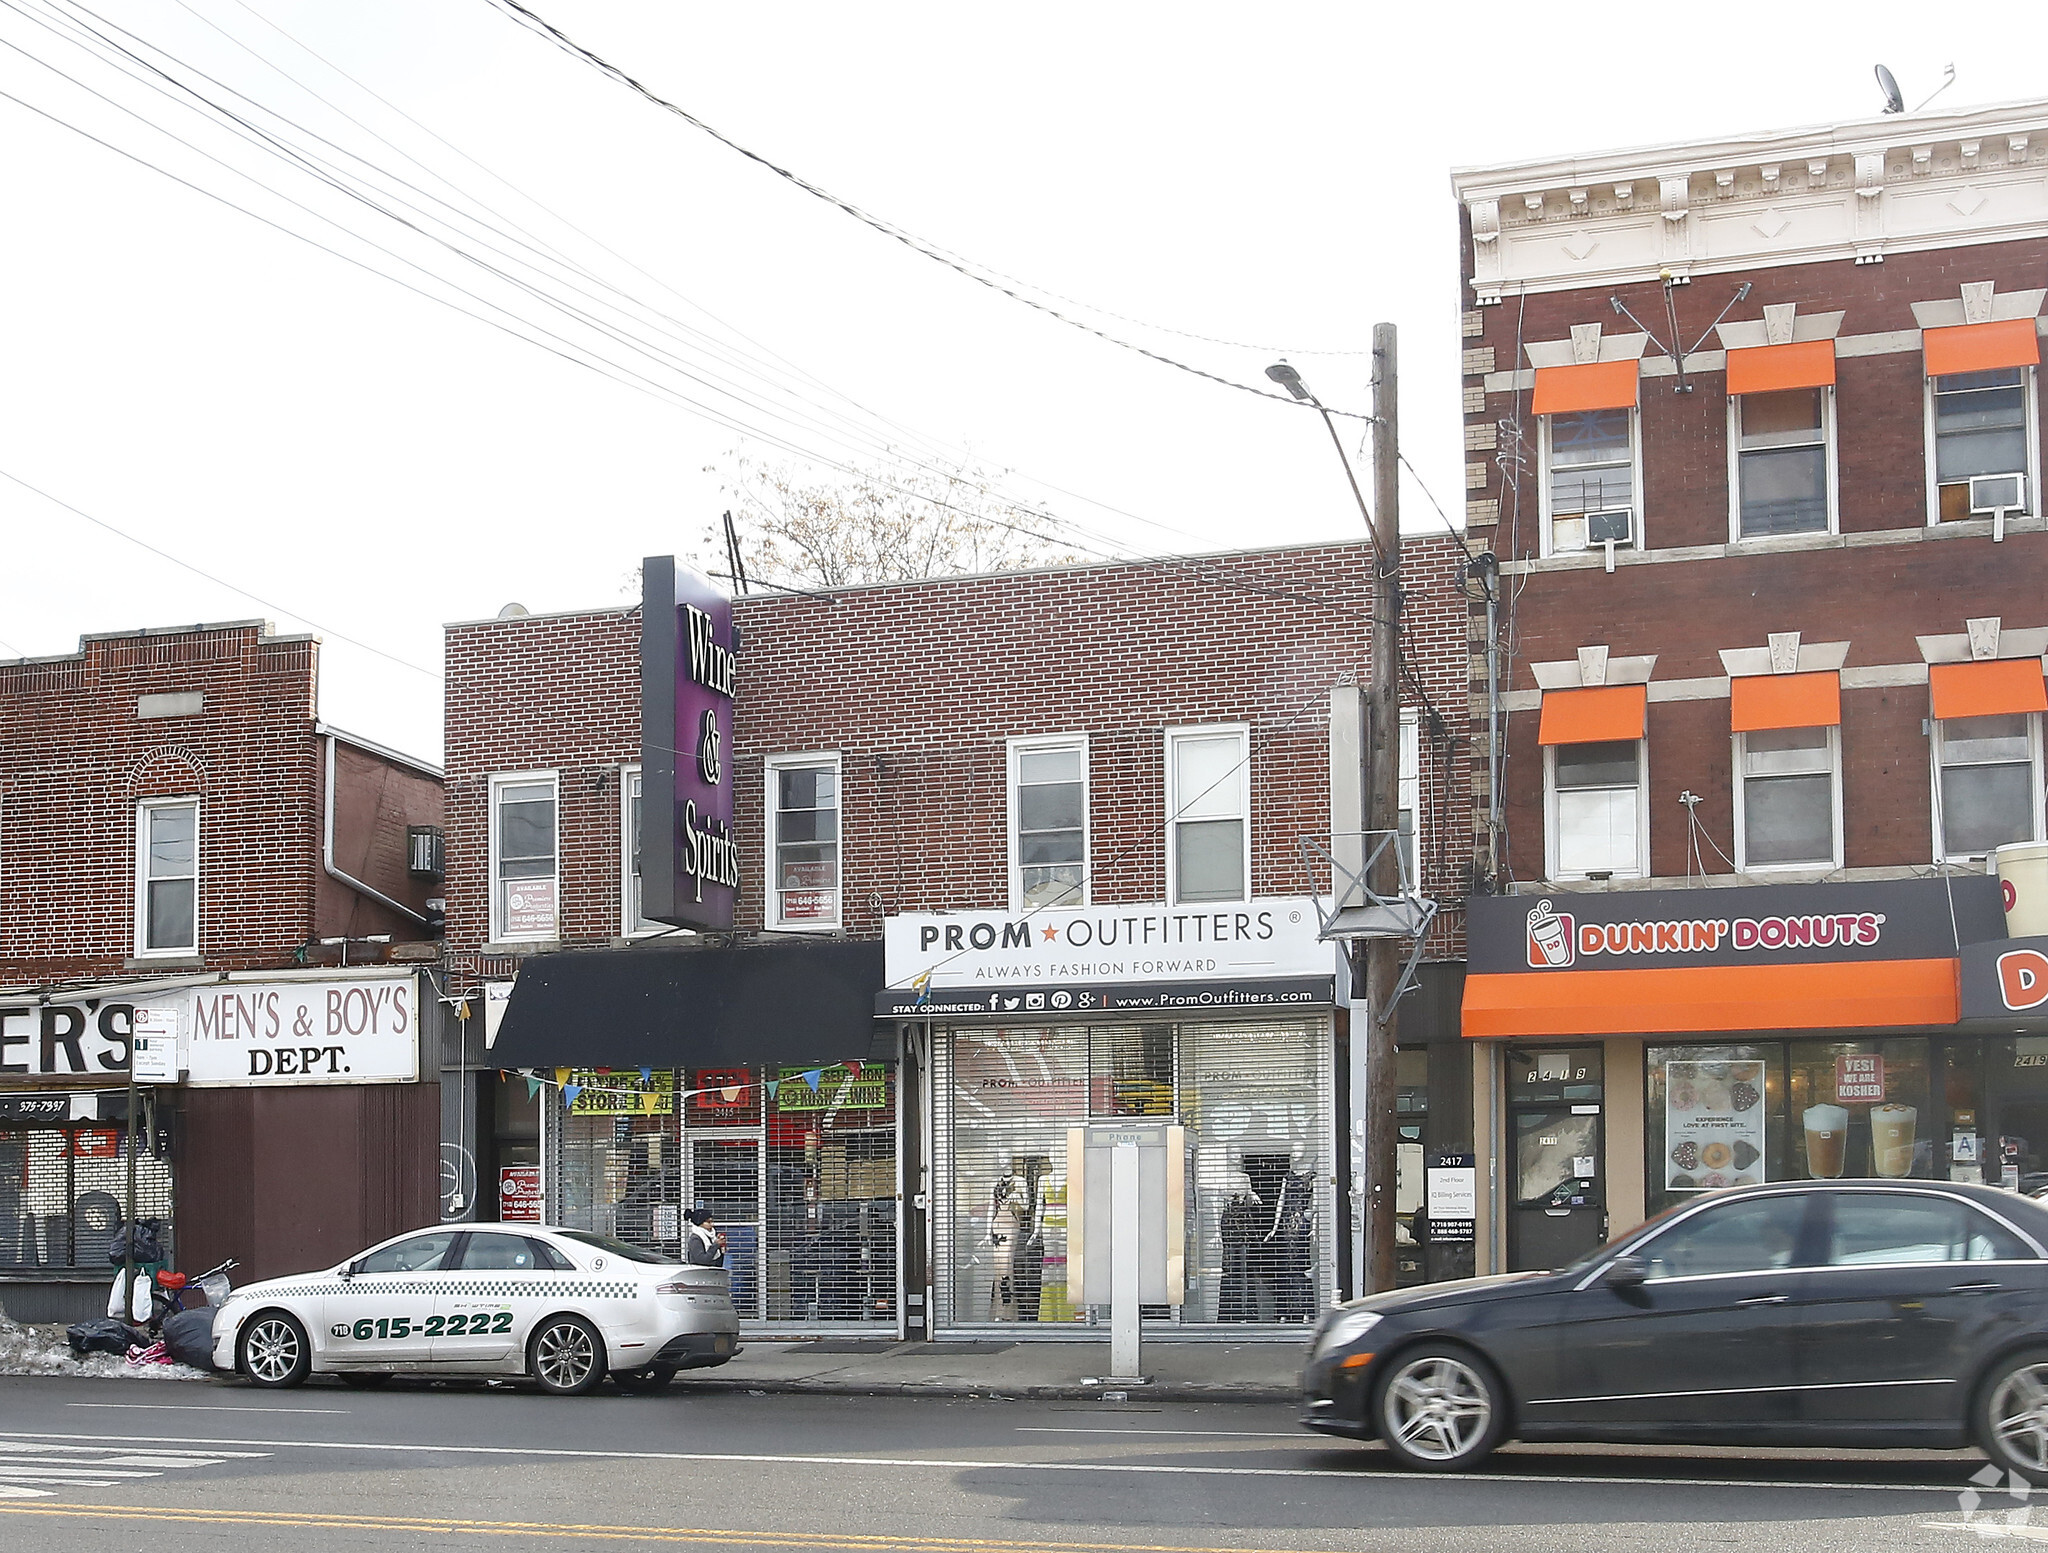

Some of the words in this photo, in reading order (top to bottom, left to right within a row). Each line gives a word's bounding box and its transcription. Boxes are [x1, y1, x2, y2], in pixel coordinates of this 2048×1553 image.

[685, 603, 737, 699] Wine
[702, 709, 721, 786] &
[685, 799, 738, 903] Spirits
[516, 884, 547, 892] AVAILABLE
[920, 921, 1033, 952] PROM
[1066, 911, 1275, 947] OUTFITTERS
[1581, 921, 1727, 953] DUNKIN'
[1734, 914, 1878, 948] DONUTS
[975, 962, 1042, 979] ALWAYS
[1050, 961, 1124, 977] FASHION
[1132, 958, 1217, 974] FORWARD
[892, 1004, 917, 1014] STAY
[919, 1003, 985, 1013] CONNECTED:
[1115, 990, 1313, 1008] www.PromOutfitters.com
[193, 991, 280, 1041] MEN'S
[292, 1004, 314, 1037] &
[326, 985, 409, 1036] BOY'S
[248, 1046, 351, 1076] DEPT.
[1845, 1060, 1875, 1072] YES!
[2015, 1055, 2047, 1066] 2419
[1843, 1073, 1858, 1083] WE
[1858, 1073, 1876, 1083] ARE
[1839, 1085, 1881, 1097] KOSHER
[1108, 1133, 1142, 1141] Phone
[1957, 1136, 1972, 1153] A
[1440, 1156, 1463, 1166] 2417
[1438, 1191, 1452, 1199] Billing
[594, 1258, 603, 1270] 9
[333, 1325, 349, 1336] 718
[352, 1312, 514, 1340] 615-2222
